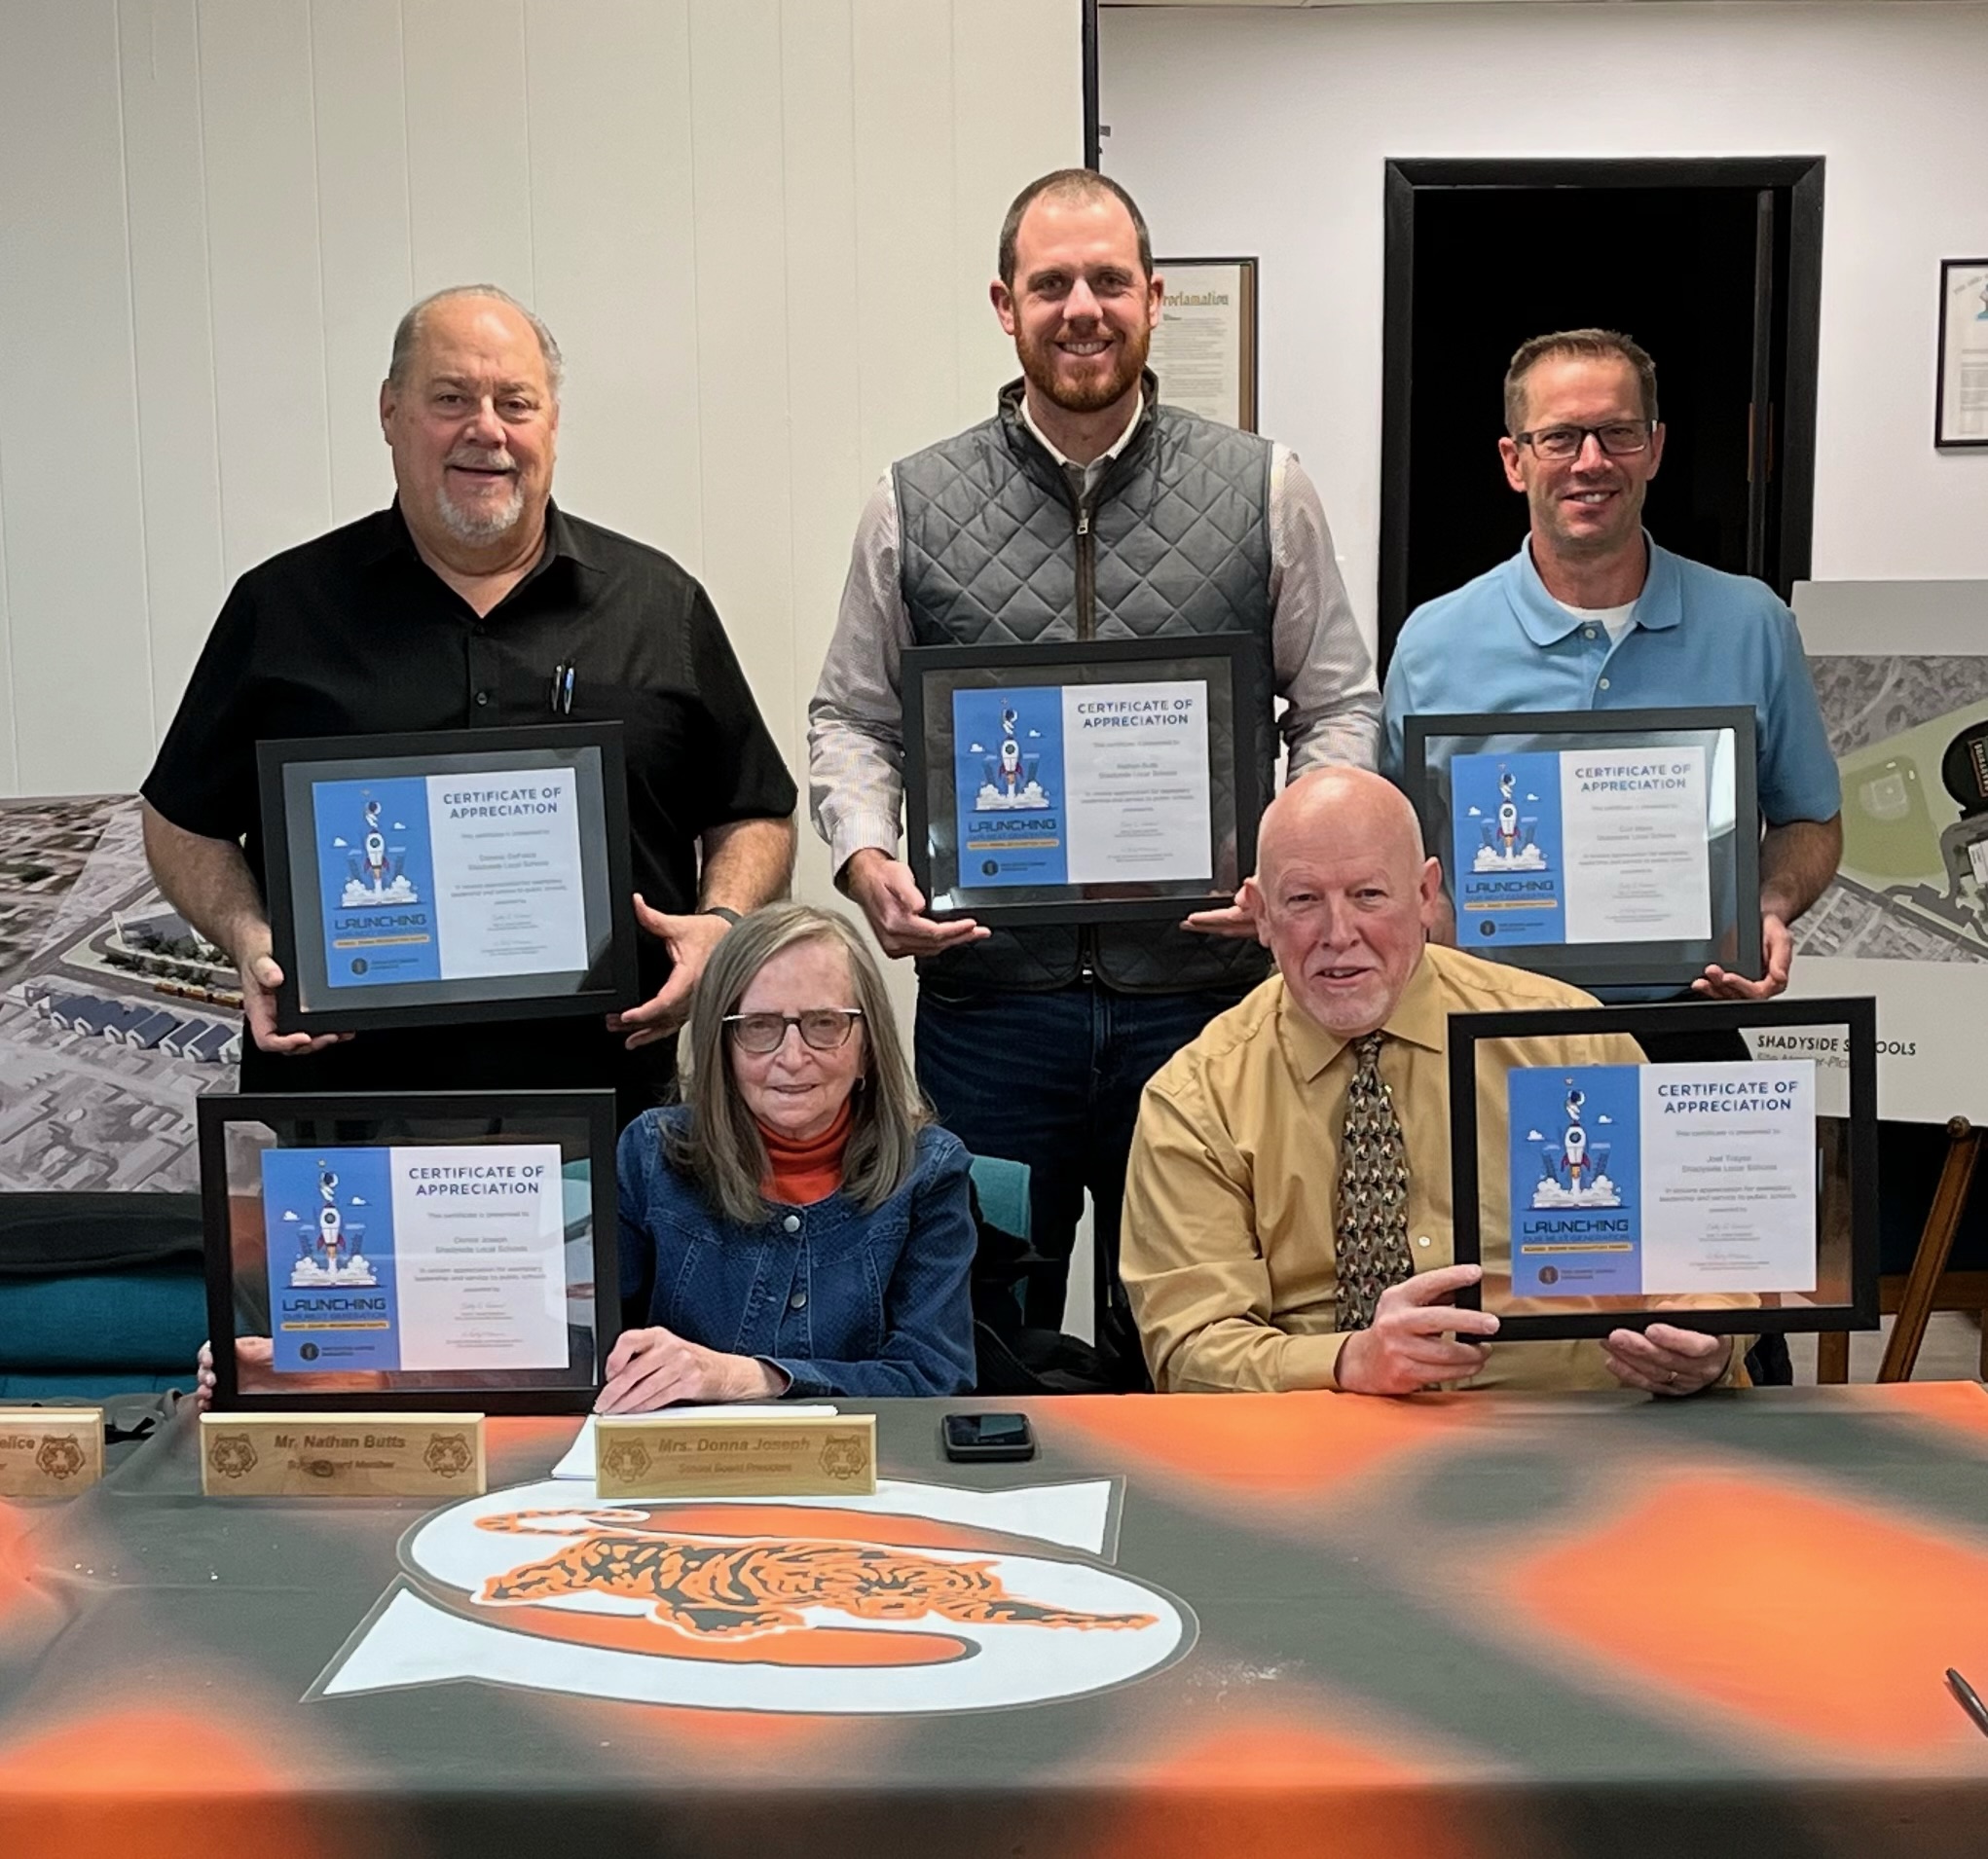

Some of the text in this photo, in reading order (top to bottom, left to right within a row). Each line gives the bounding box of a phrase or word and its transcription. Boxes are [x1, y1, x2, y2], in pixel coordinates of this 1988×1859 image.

[1162, 291, 1229, 306] roclamation
[1078, 699, 1193, 714] CERTIFICATE OF
[1083, 714, 1189, 728] APPRECIATION
[1575, 765, 1691, 779] CERTIFICATE OF
[1581, 779, 1686, 792] APPRECIATION
[444, 786, 562, 804] CERTIFICATE OF
[450, 802, 558, 819] APPRECIATION
[968, 819, 1056, 832] LAUNCHING
[1466, 880, 1554, 893] LAUNCHING
[335, 913, 426, 930] LAUNCHING
[1756, 1035, 1916, 1055] SHADYSIDE SOOLS
[1658, 1080, 1799, 1096] CERTIFICATE OF
[1665, 1099, 1791, 1113] APPRECIATION
[409, 1165, 545, 1180] CERTIFICATE OF
[416, 1182, 539, 1196] APPRECIATION
[1523, 1219, 1628, 1234] LAUNCHING
[282, 1298, 386, 1312] LAUNCHING
[275, 1435, 406, 1448] Mr. Nathan Butts
[658, 1437, 810, 1452] Mrs. Donna Joseph
